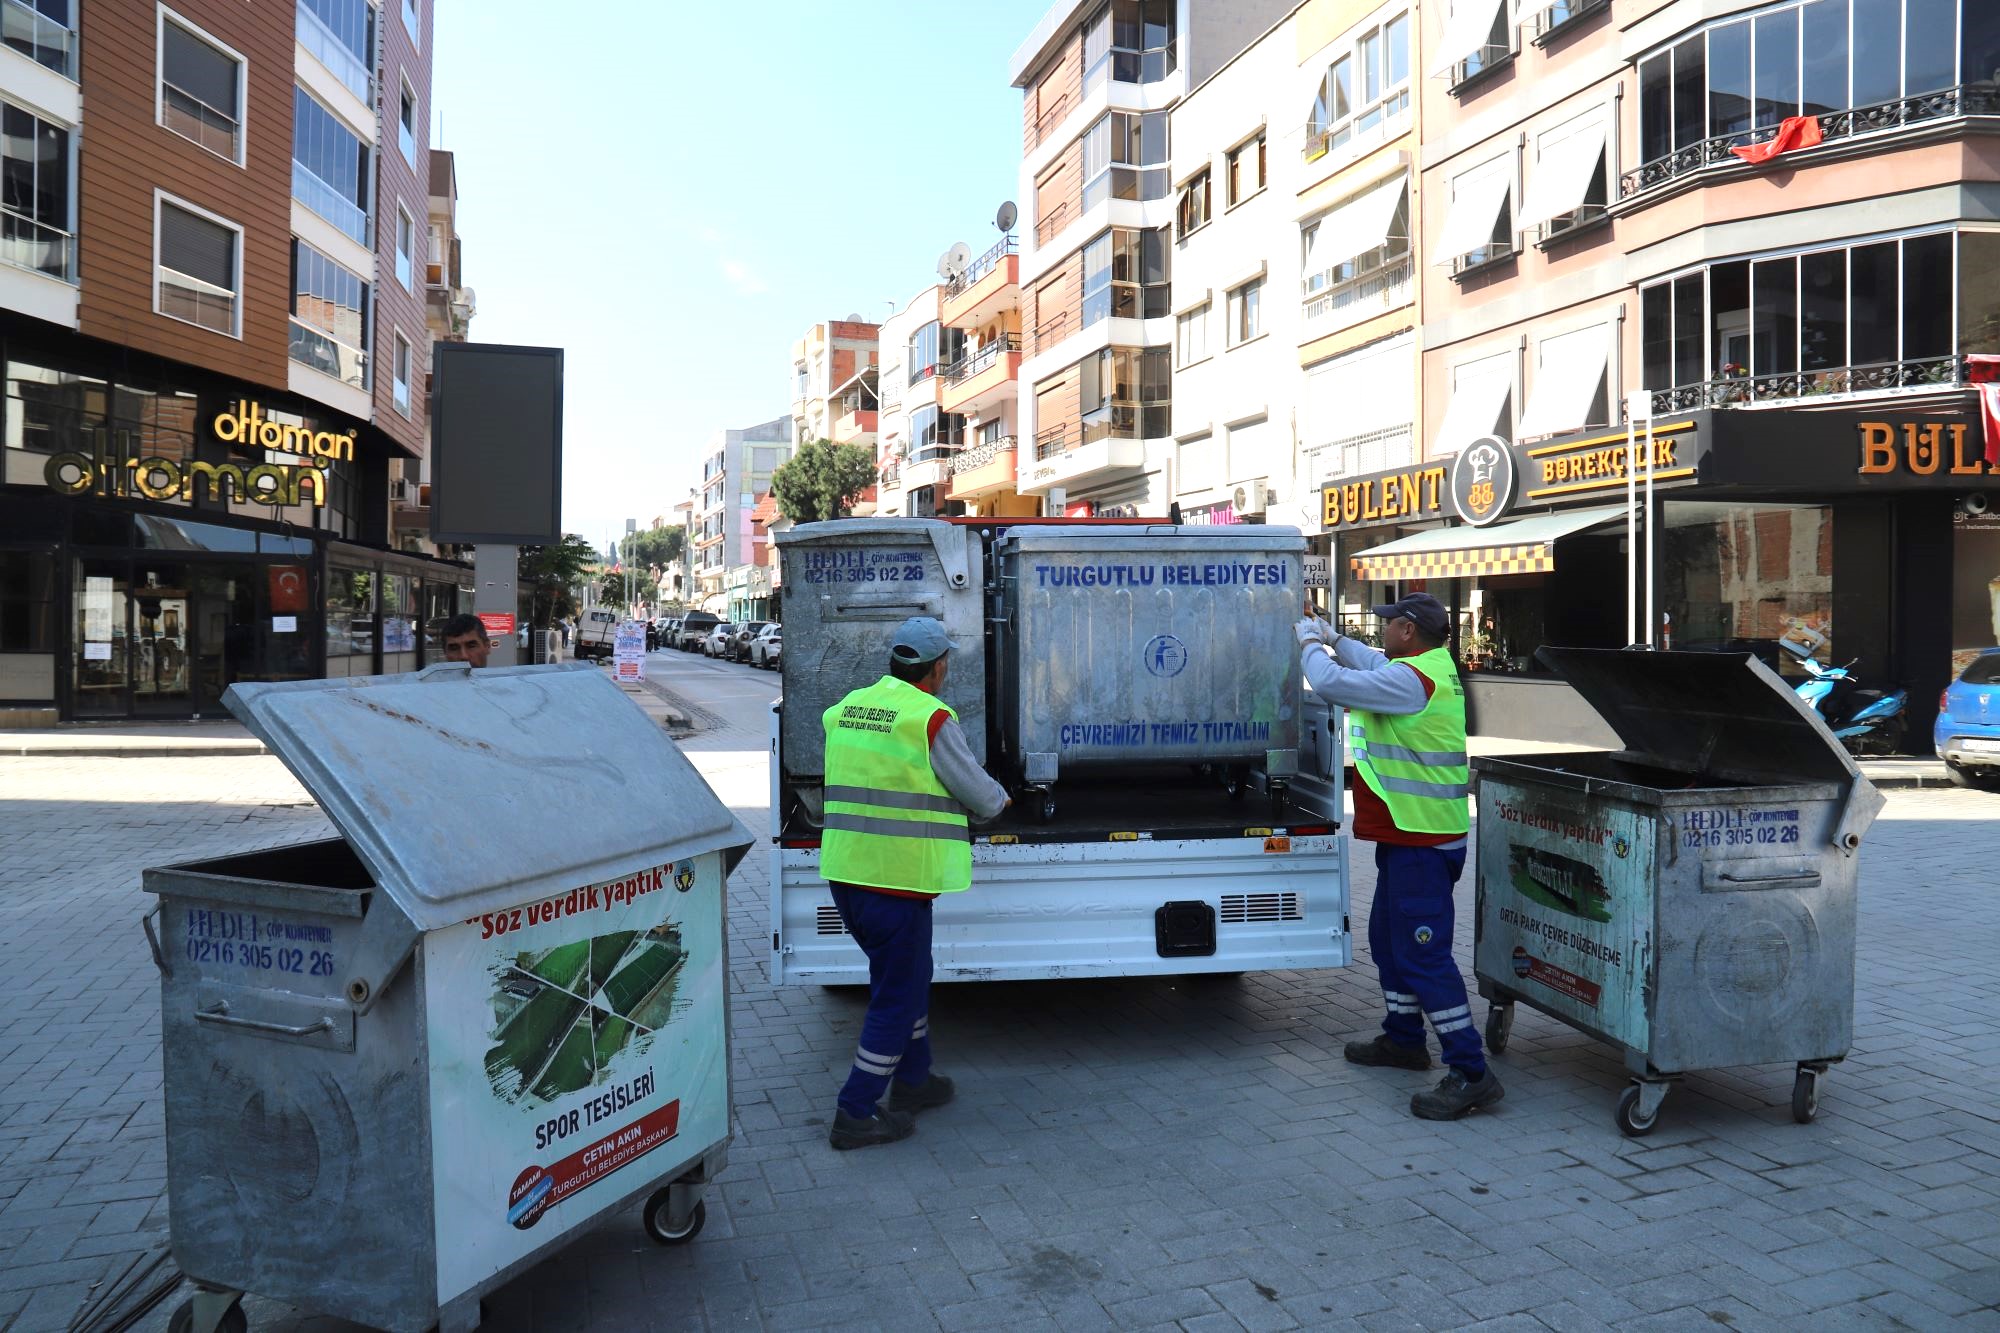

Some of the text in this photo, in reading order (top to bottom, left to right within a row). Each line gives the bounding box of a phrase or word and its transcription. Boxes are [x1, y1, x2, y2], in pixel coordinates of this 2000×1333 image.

[213, 399, 354, 461] ottoman
[1858, 422, 2000, 474] BÜL
[43, 428, 326, 507] ottoman
[1542, 438, 1674, 481] BÖREKÇLİK
[1323, 466, 1444, 525] BÜLENT
[804, 565, 924, 583] 0216 305 02 26
[1035, 560, 1286, 586] TURGUTLU BELEDİYESİ
[1303, 558, 1326, 574] rpil
[1303, 573, 1330, 585] aför
[1060, 719, 1270, 750] ÇEVREMİZİ TEMİZ TUTALIM
[1683, 825, 1799, 848] 0216 305 02 26
[527, 885, 599, 927] verdik
[186, 938, 334, 977] 0216 305 02 26
[1500, 907, 1518, 928] ORTA
[1520, 914, 1541, 935] PARK
[1570, 932, 1621, 968] DÜZENLEME
[535, 1065, 656, 1150] SPOR TESİSLERİ
[552, 1127, 668, 1198] TURGUTLU BELEDİYE BAŞKANI
[582, 1124, 642, 1168] ÇETİN AKIN
[512, 1169, 542, 1200] TAMAMI
[519, 1197, 547, 1225] YAPILDI
